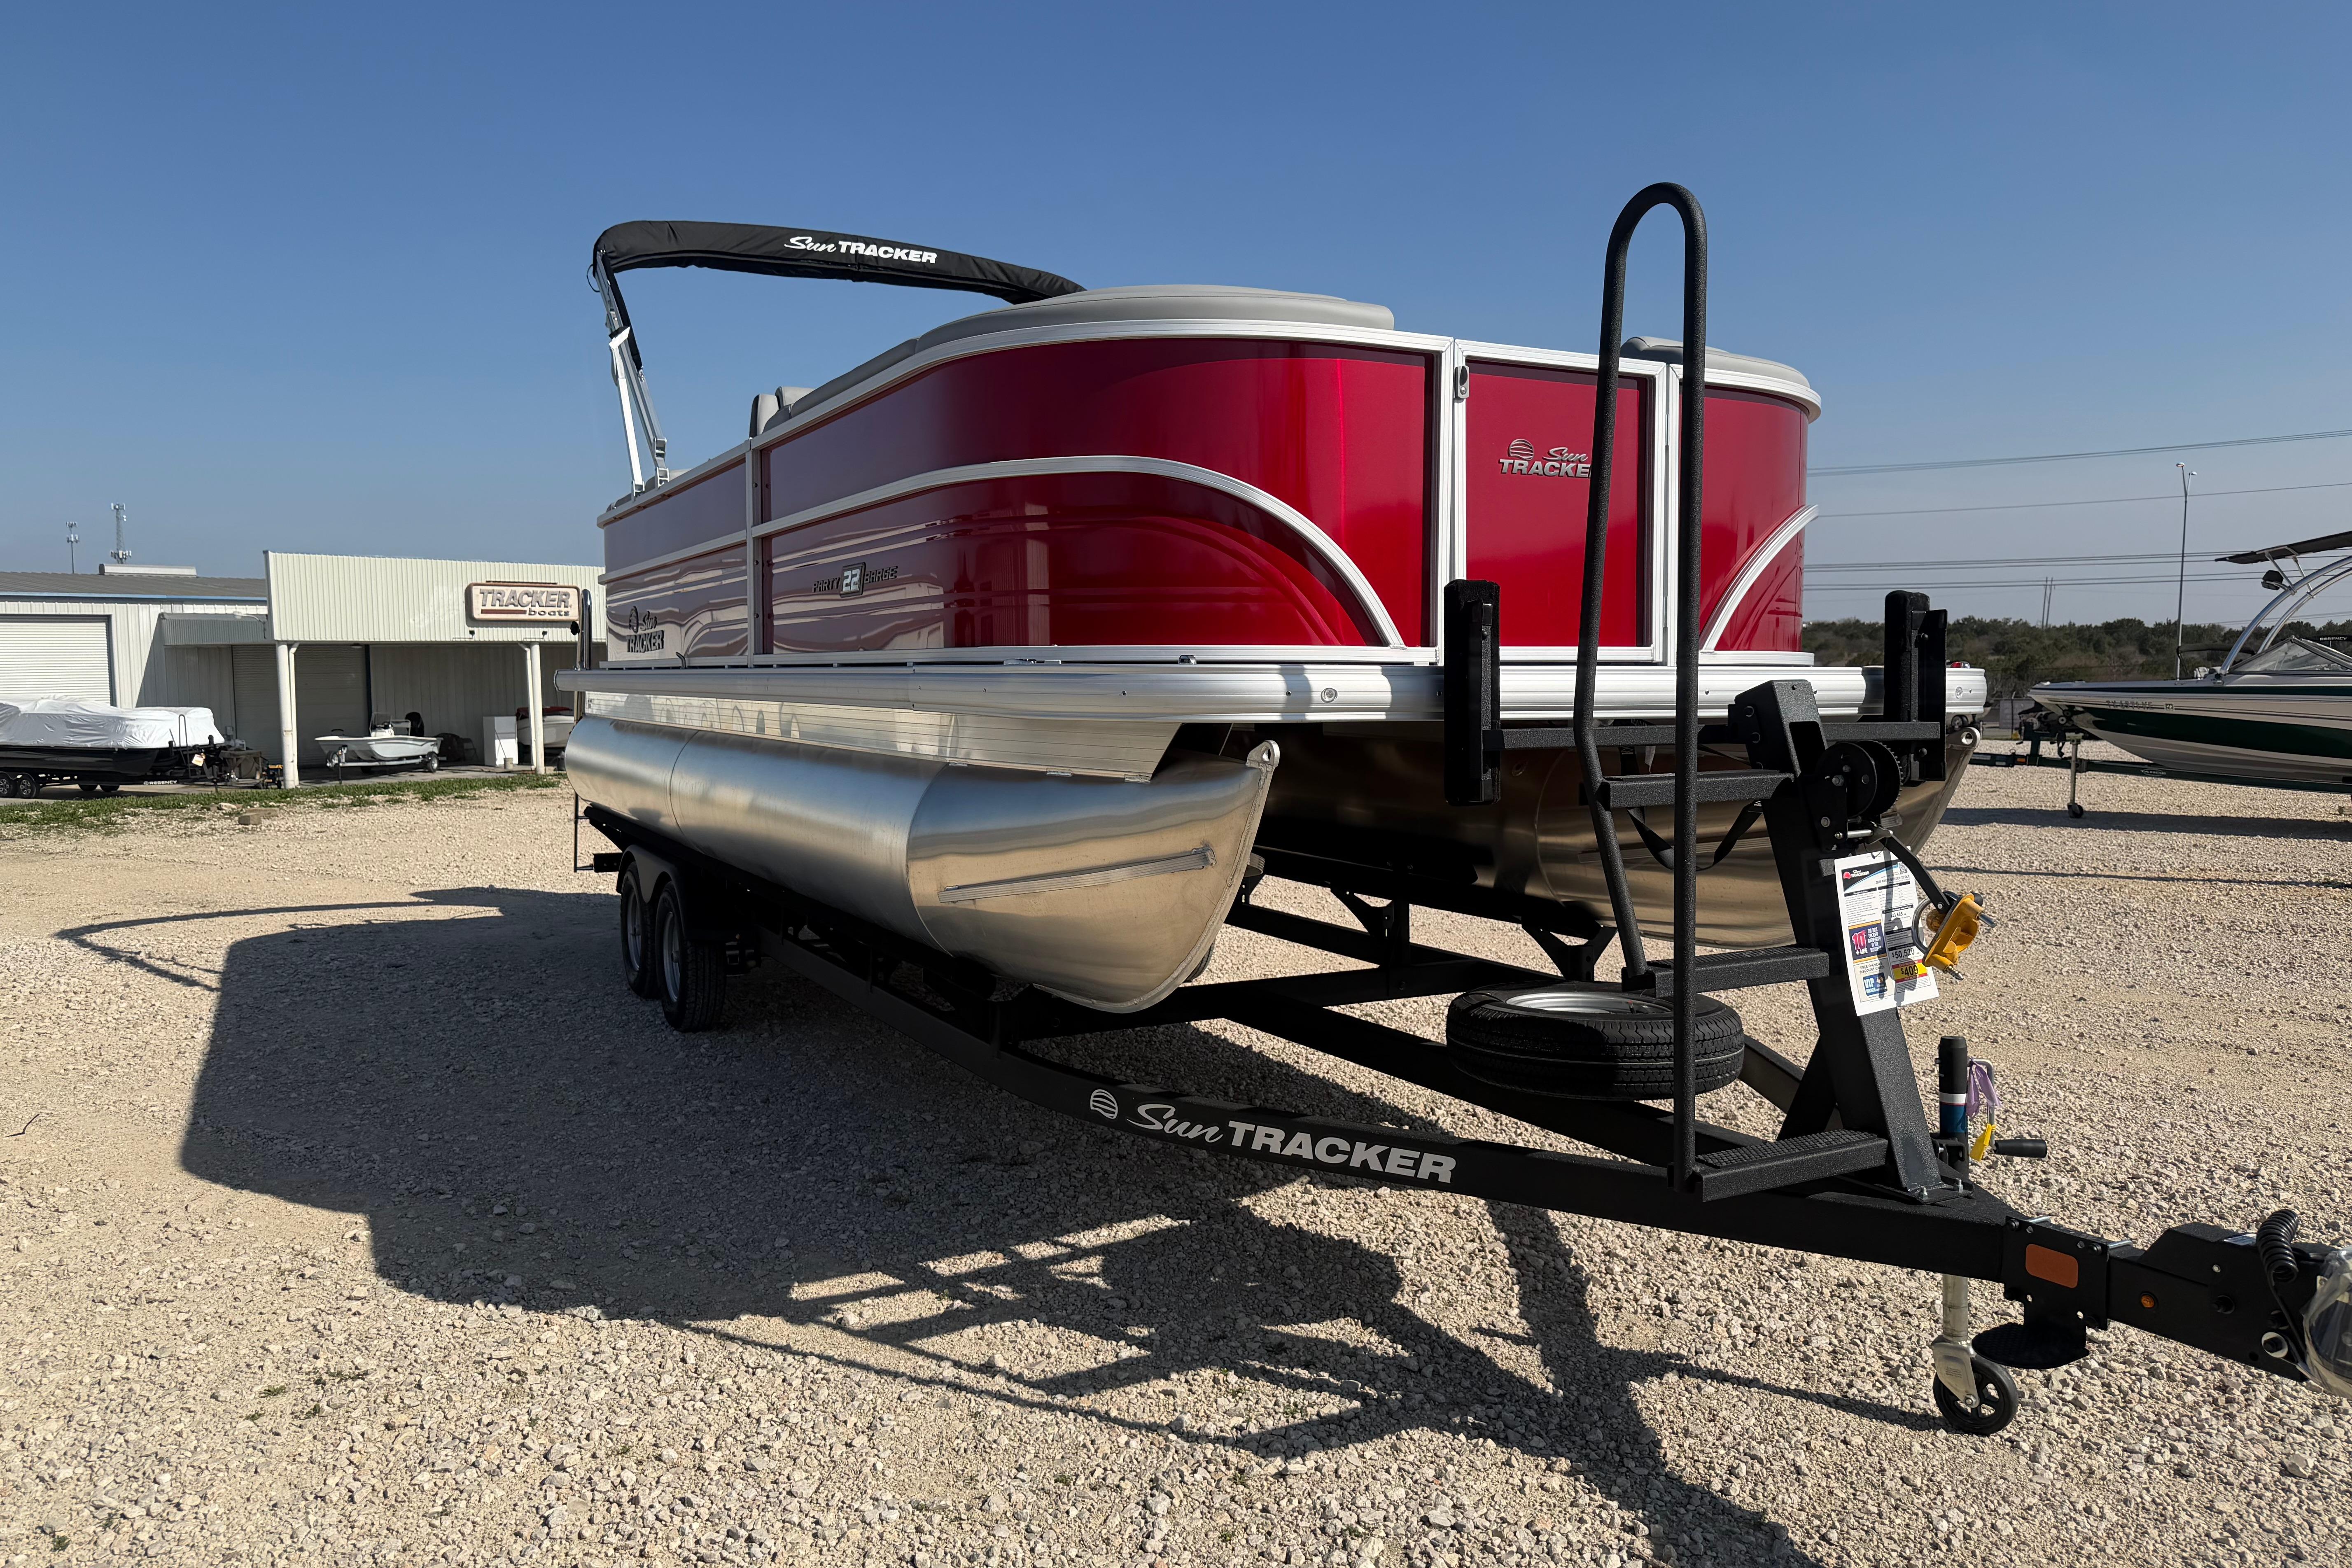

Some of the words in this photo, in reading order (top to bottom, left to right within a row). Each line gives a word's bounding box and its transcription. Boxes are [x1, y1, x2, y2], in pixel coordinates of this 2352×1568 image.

[784, 236, 837, 252] Sun
[838, 241, 937, 264] TRACKER
[1542, 447, 1588, 462] Sun
[1498, 459, 1592, 478] TRACKE
[812, 577, 840, 593] PARTY
[842, 569, 860, 591] 22
[864, 566, 898, 583] BARGE
[480, 589, 571, 608] TRACKER
[528, 607, 570, 616] boats
[626, 630, 665, 653] TRACKER
[1892, 948, 1914, 959] $50,520
[1901, 965, 1918, 976] $409
[1864, 978, 1874, 988] VIP
[1126, 1104, 1223, 1143] Sun
[1228, 1120, 1457, 1183] TRACKER
